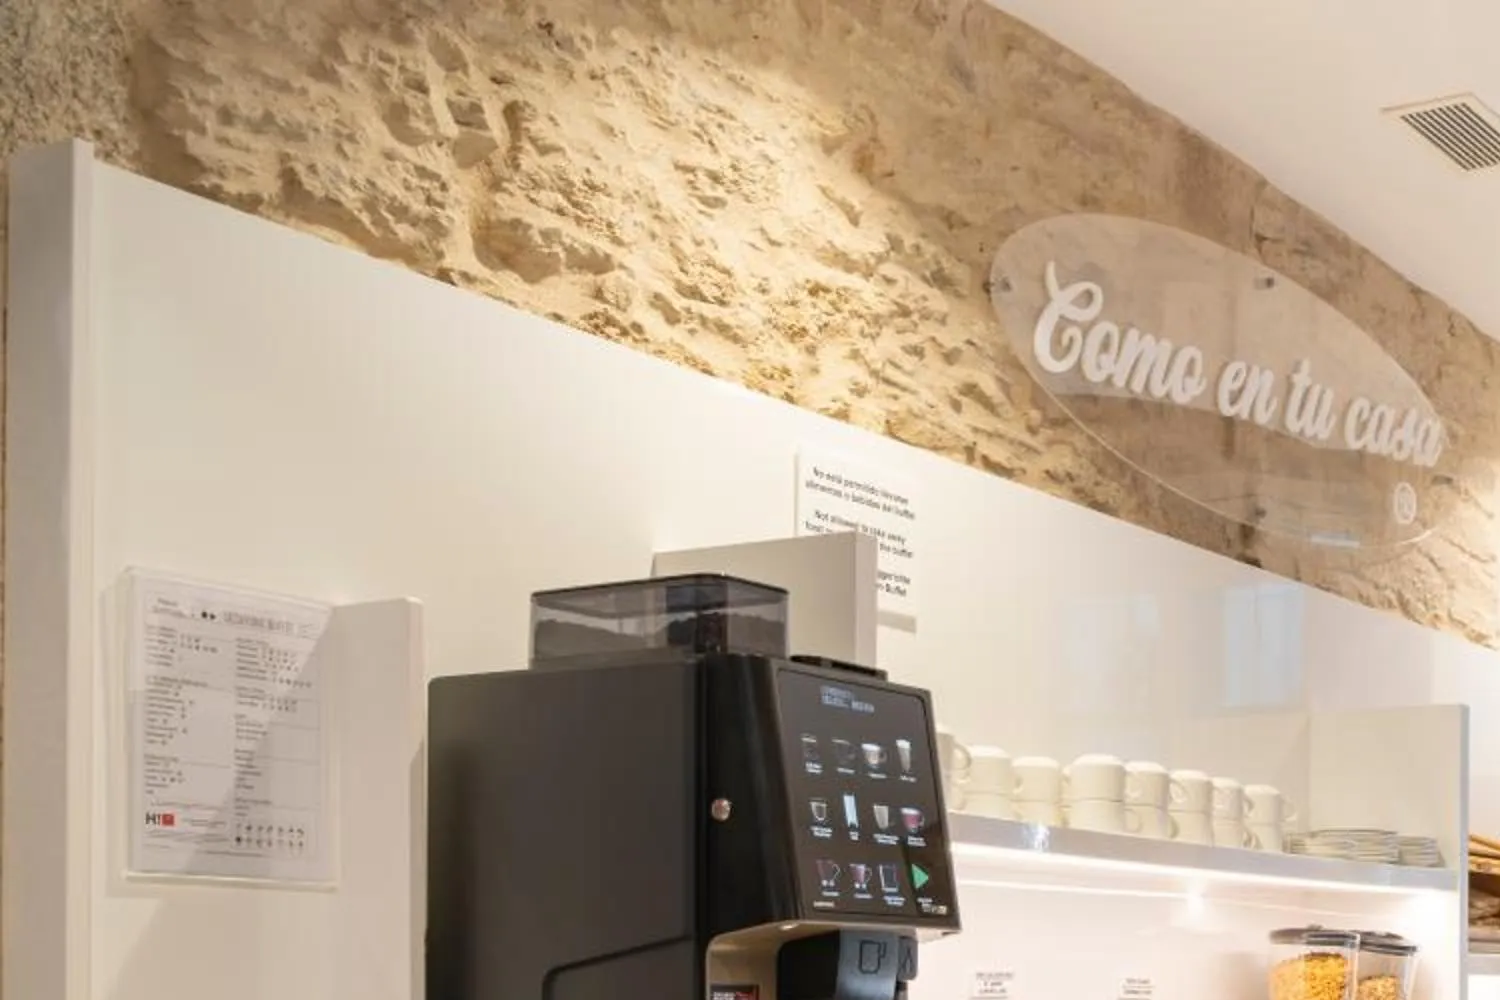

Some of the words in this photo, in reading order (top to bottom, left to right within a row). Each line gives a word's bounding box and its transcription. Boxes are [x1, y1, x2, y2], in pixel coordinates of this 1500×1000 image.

[1034, 260, 1207, 405] Como
[1217, 361, 1278, 425] en
[1285, 359, 1338, 440] tu
[1344, 397, 1443, 468] casa
